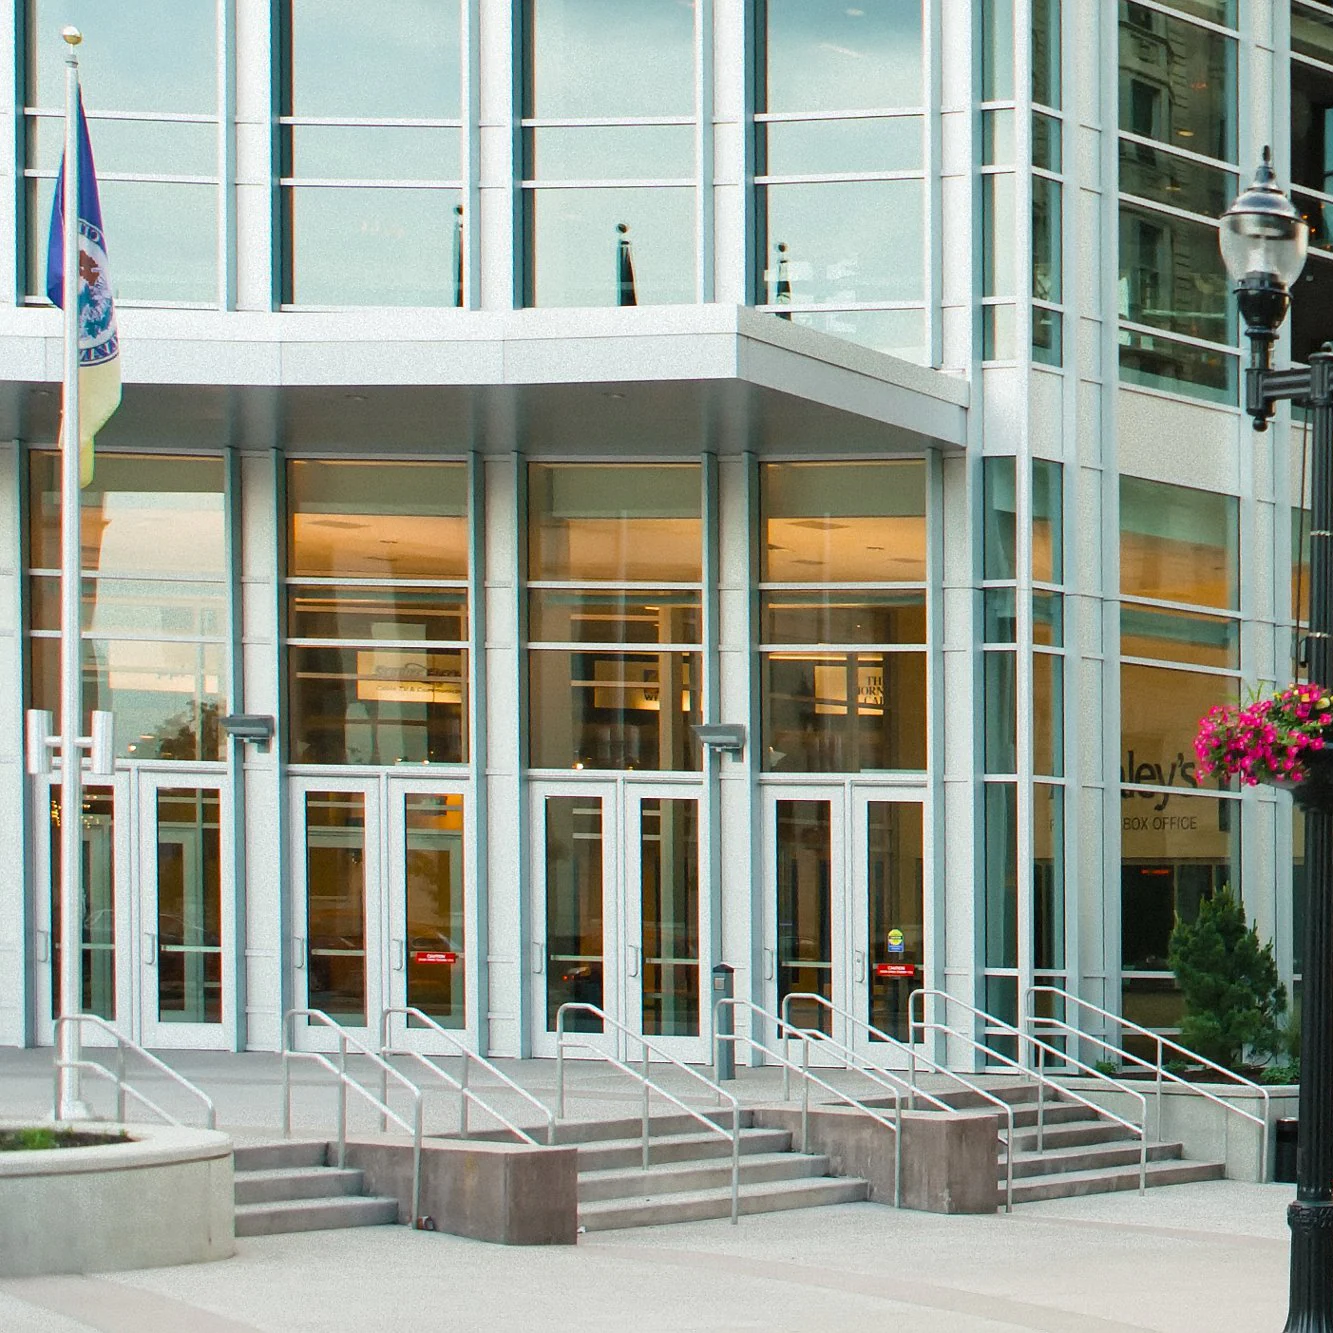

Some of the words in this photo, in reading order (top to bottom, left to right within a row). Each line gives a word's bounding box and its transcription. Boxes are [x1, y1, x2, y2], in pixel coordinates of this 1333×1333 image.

[1121, 750, 1198, 811] ley's
[1124, 817, 1148, 831] BOX
[1153, 816, 1197, 830] OFFICE
